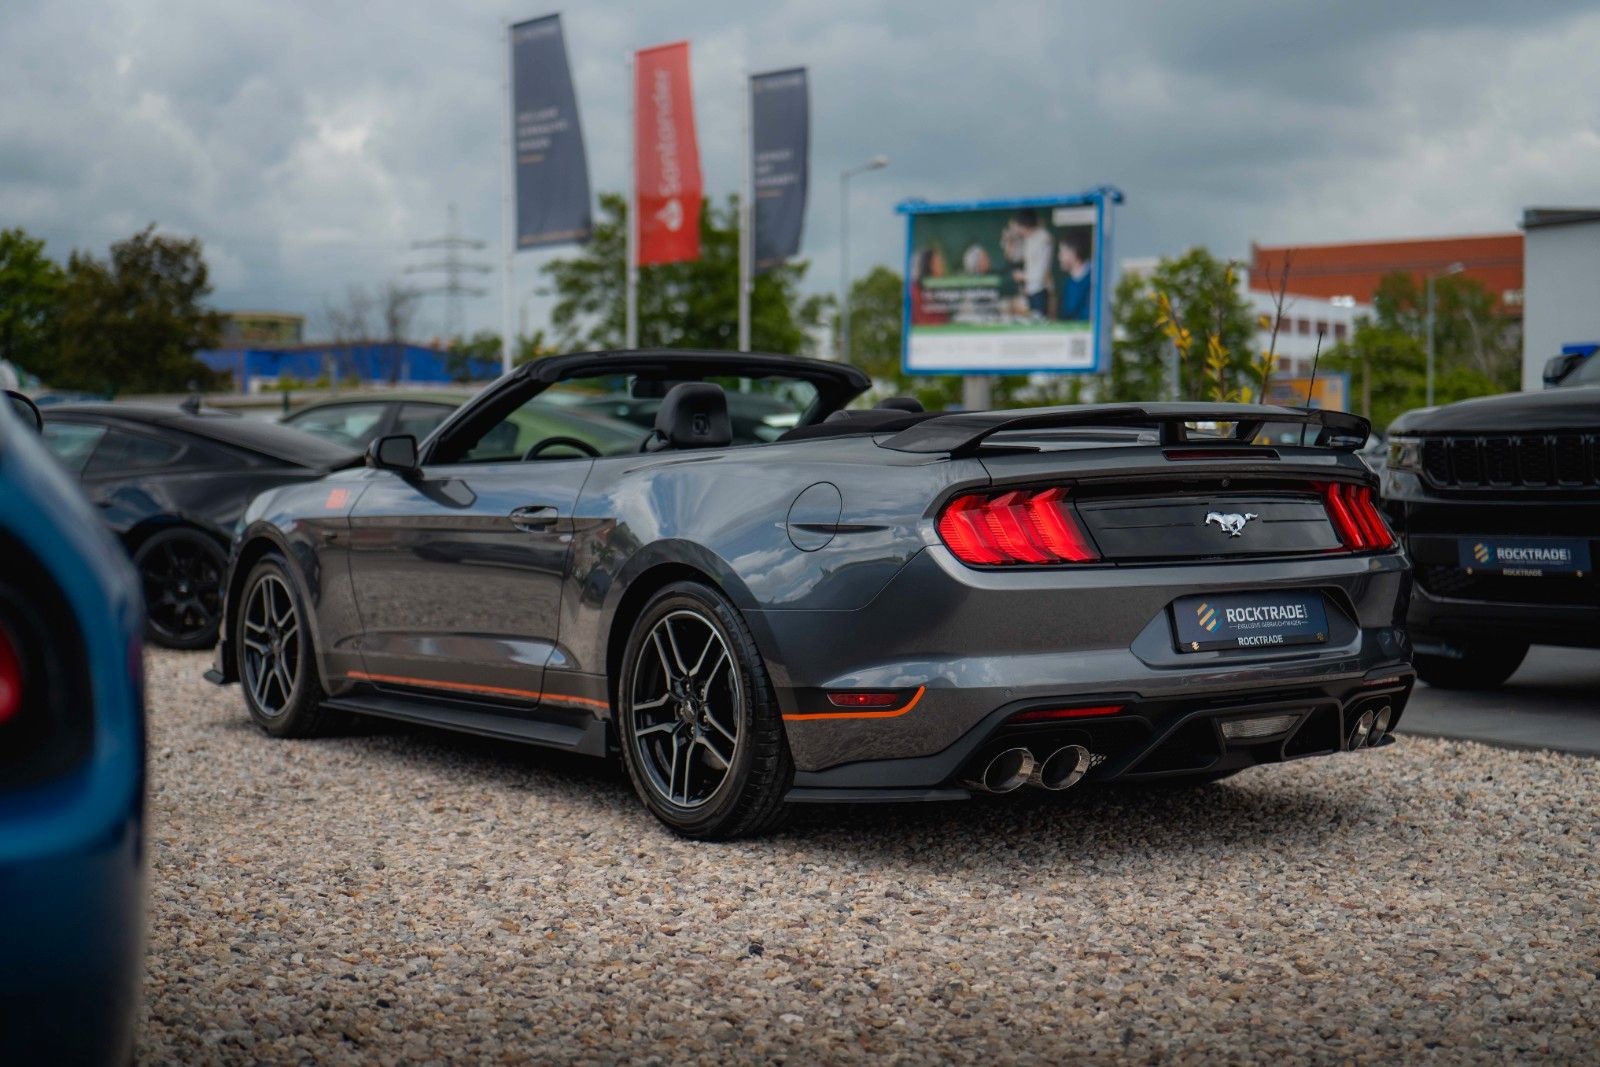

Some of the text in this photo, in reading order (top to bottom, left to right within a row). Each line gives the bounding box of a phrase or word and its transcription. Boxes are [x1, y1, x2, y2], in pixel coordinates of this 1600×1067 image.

[1496, 547, 1567, 561] ROCKTRADE
[1226, 604, 1304, 623] ROCKTRADE
[1237, 634, 1284, 646] ROCKTRADE
